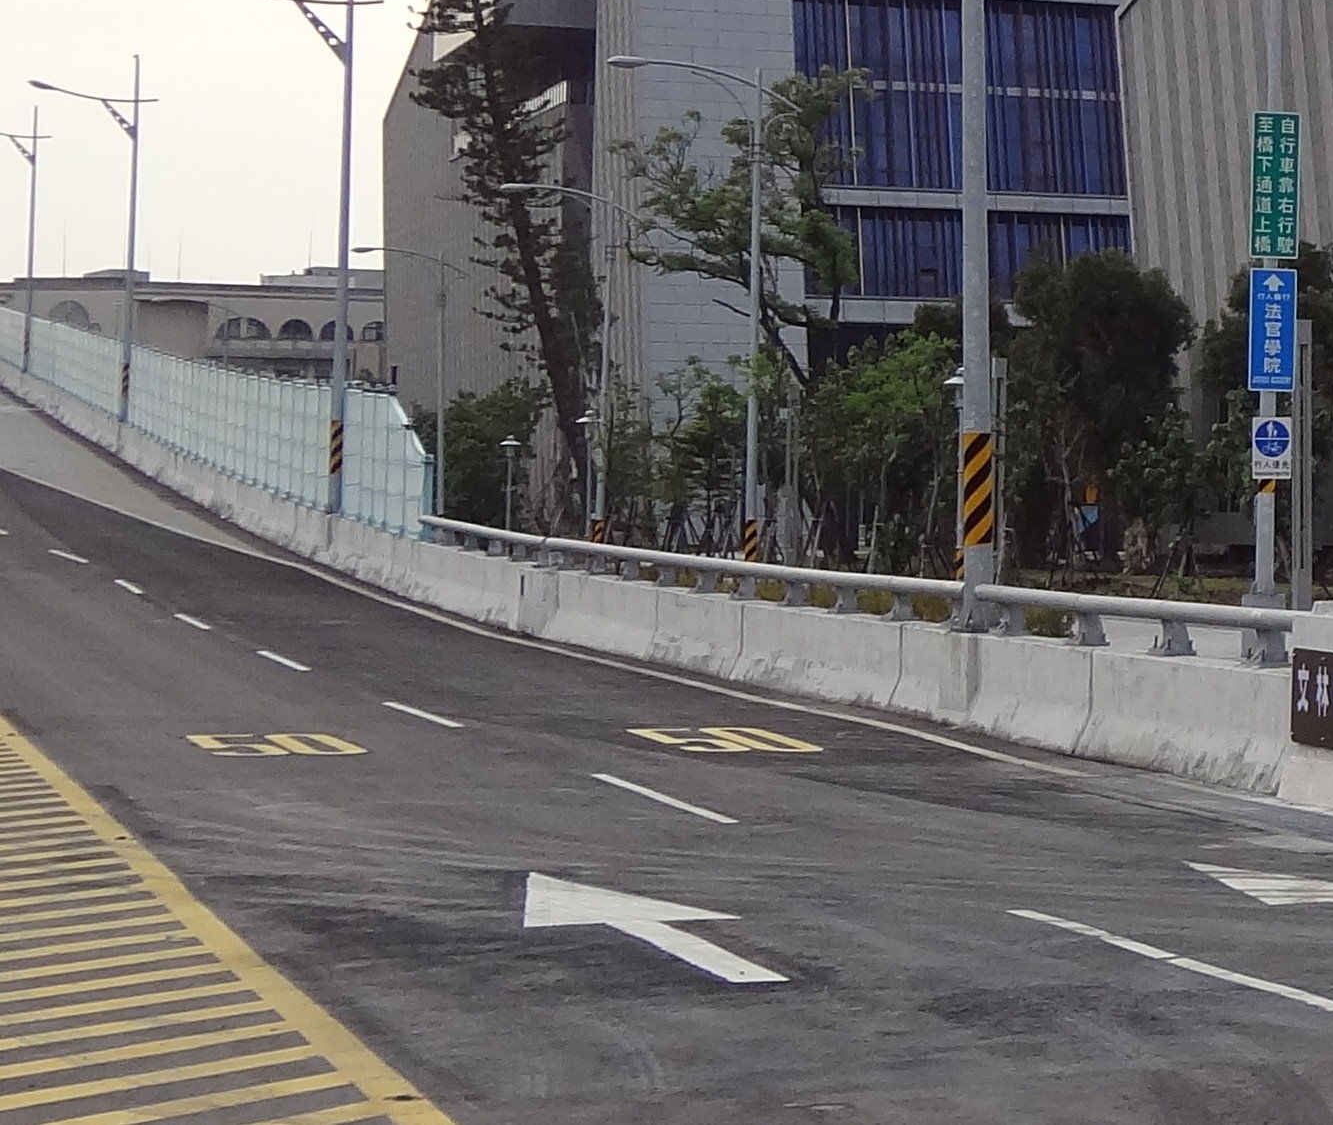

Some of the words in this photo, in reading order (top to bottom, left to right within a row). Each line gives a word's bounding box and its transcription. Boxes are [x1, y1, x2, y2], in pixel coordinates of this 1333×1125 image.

[1254, 116, 1275, 254] 至橋下通道上橋
[1277, 117, 1295, 254] 自行車靠右行駛
[1263, 303, 1283, 374] 法官學院
[185, 732, 368, 757] 50
[625, 726, 824, 753] 50
